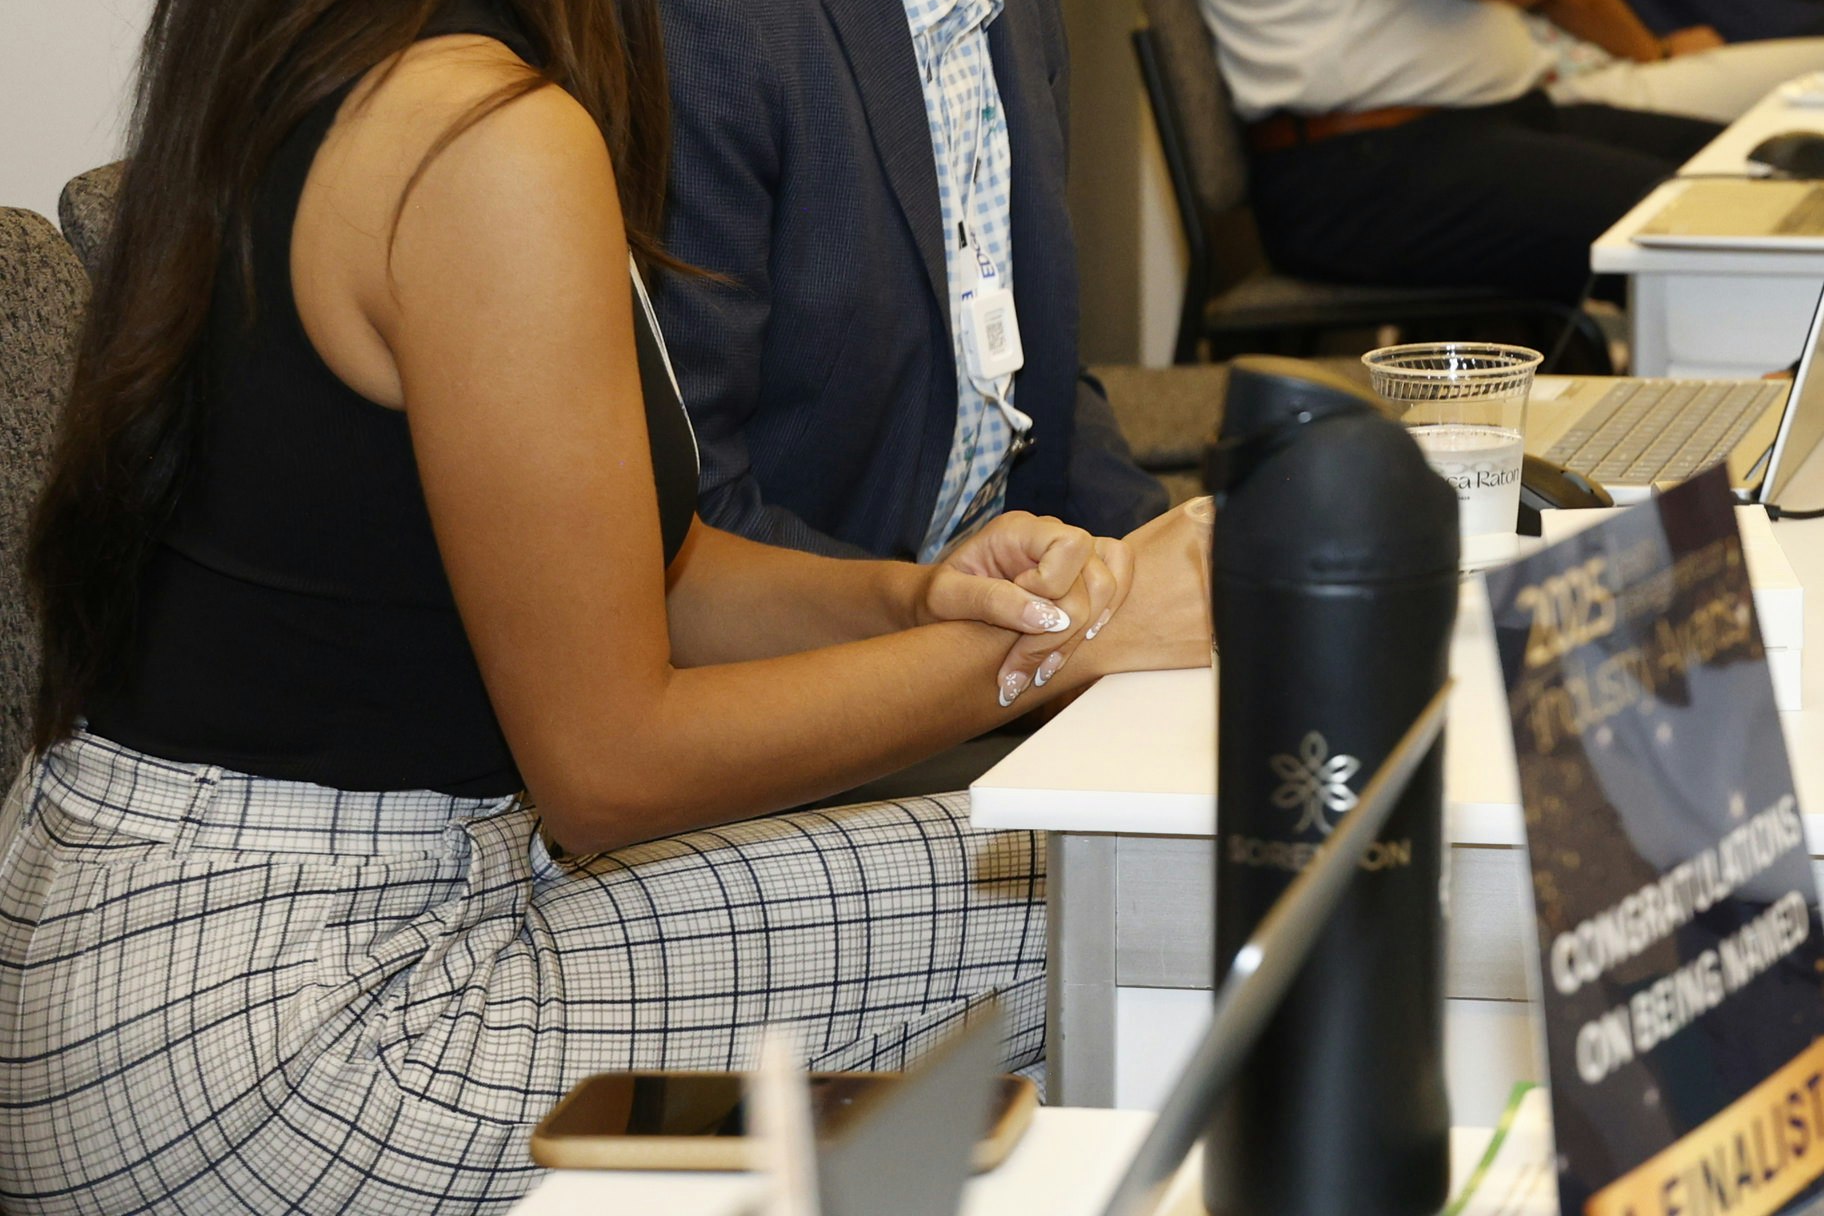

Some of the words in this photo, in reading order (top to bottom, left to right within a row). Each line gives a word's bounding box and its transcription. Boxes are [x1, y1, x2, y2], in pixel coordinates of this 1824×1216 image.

[1476, 467, 1521, 489] Raton
[1550, 792, 1803, 996] CONGRATULATIONS
[1576, 1004, 1635, 1084] ON
[1629, 949, 1726, 1053] BEING
[1718, 890, 1810, 992] NAMED
